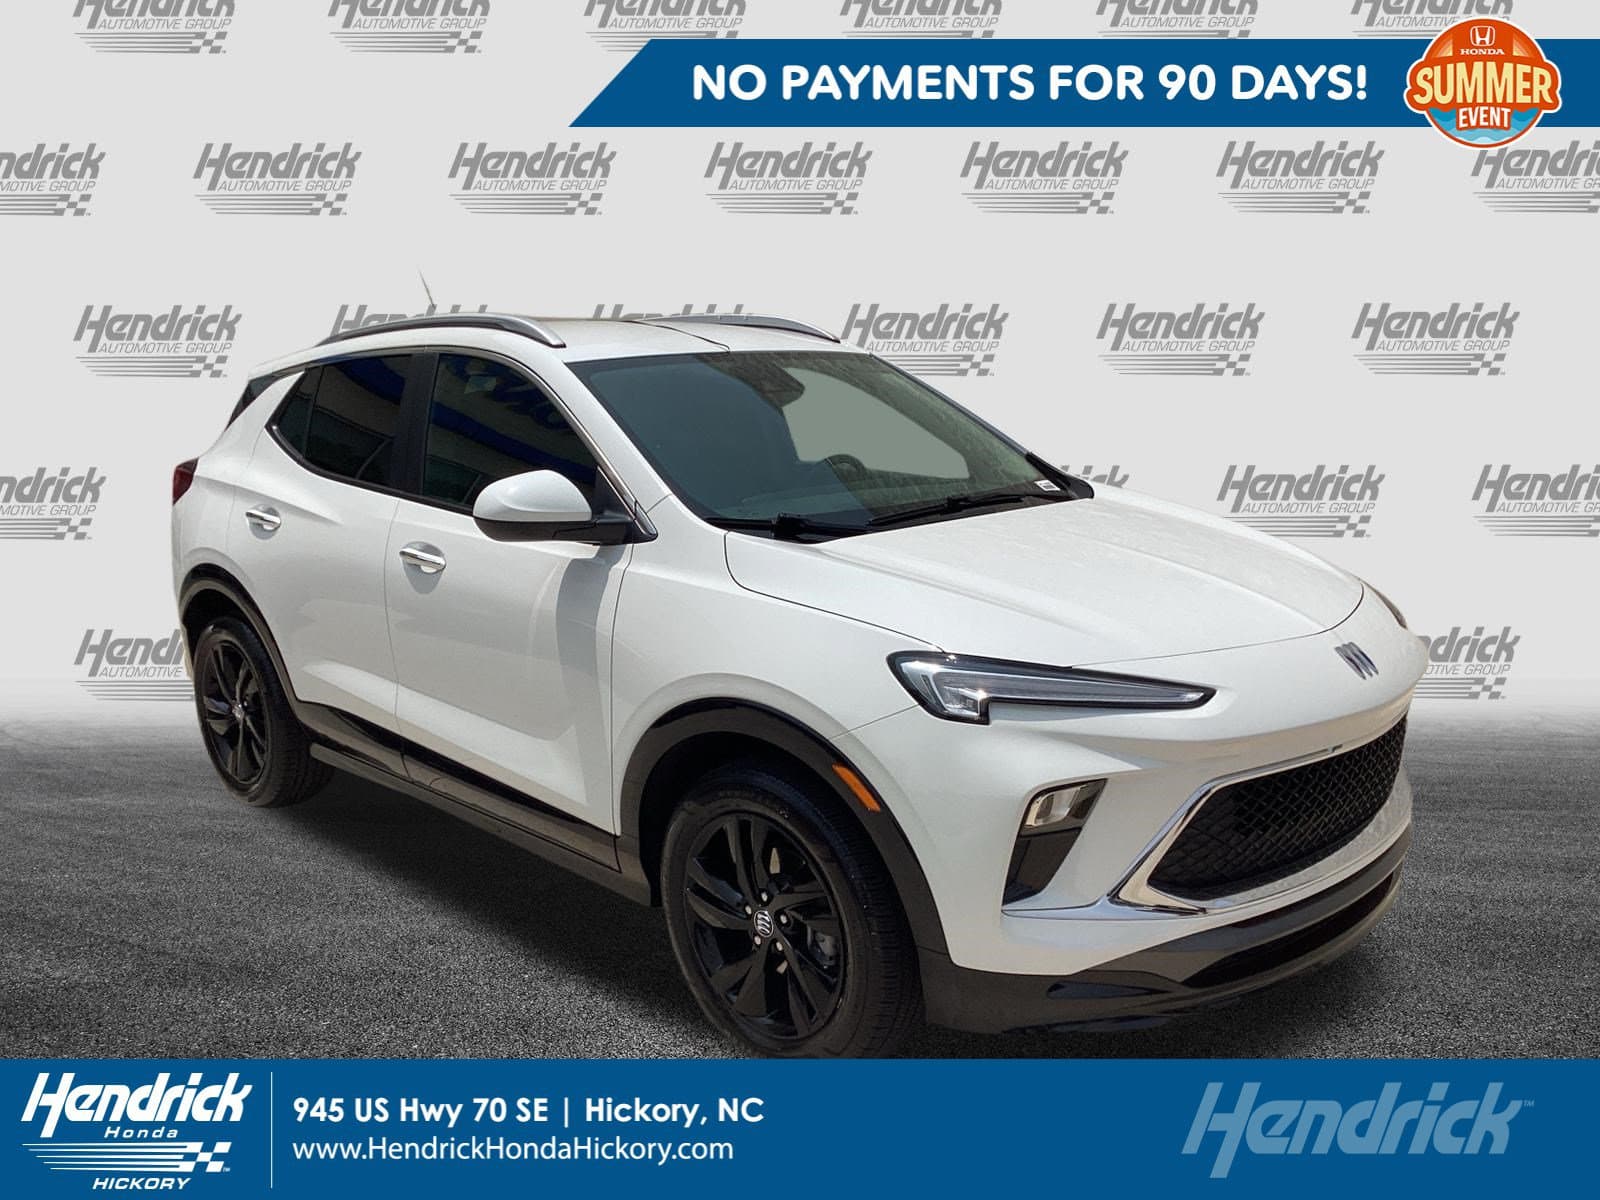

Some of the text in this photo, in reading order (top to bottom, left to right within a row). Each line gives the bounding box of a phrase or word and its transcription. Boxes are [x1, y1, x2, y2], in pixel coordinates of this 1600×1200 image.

[97, 18, 231, 29] AUTOMOTIVE GROUP
[352, 18, 486, 29] AUTOMOTIVE GROUP
[608, 17, 742, 28] AUTOMOTIVE GROUP
[864, 17, 998, 28] AUTOMOTIVE GROUP
[1120, 16, 1254, 27] AUTOMOTIVE GROUP
[193, 143, 362, 191] Hendrick
[448, 143, 617, 191] Hendrick
[704, 142, 873, 190] Hendrick
[960, 142, 1129, 190] Hendrick
[1216, 141, 1385, 189] Hendrick
[1471, 141, 1600, 189] Hendri
[49, 180, 95, 191] GROUP
[217, 180, 351, 191] AUTOMOTIVE GROUP
[472, 180, 606, 191] AUTOMOTIVE GROUP
[728, 179, 862, 190] AUTOMOTIVE GROUP
[984, 179, 1118, 190] AUTOMOTIVE GROUP
[1240, 178, 1374, 189] AUTOMOTIVE GROUP
[1495, 178, 1579, 189] AUTOMOTIVE
[73, 305, 242, 353] Hendrick
[840, 304, 1009, 352] Hendrick
[1096, 304, 1265, 352] Hendrick
[1351, 303, 1520, 351] Hendrick
[97, 342, 231, 353] AUTOMOTIVE GROUP
[864, 341, 998, 352] AUTOMOTIVE GROUP
[1120, 341, 1254, 352] AUTOMOTIVE GROUP
[1375, 340, 1509, 351] AUTOMOTIVE GROUP
[1217, 465, 1386, 513] Hendrick
[1472, 464, 1600, 512] Hendri
[50, 504, 96, 515] GROUP
[1241, 502, 1375, 513] AUTOMOTIVE GROUP
[1496, 501, 1580, 512] AUTOMOTIVE
[98, 666, 183, 677] AUTOMOTIVE
[1464, 664, 1511, 675] GROUP
